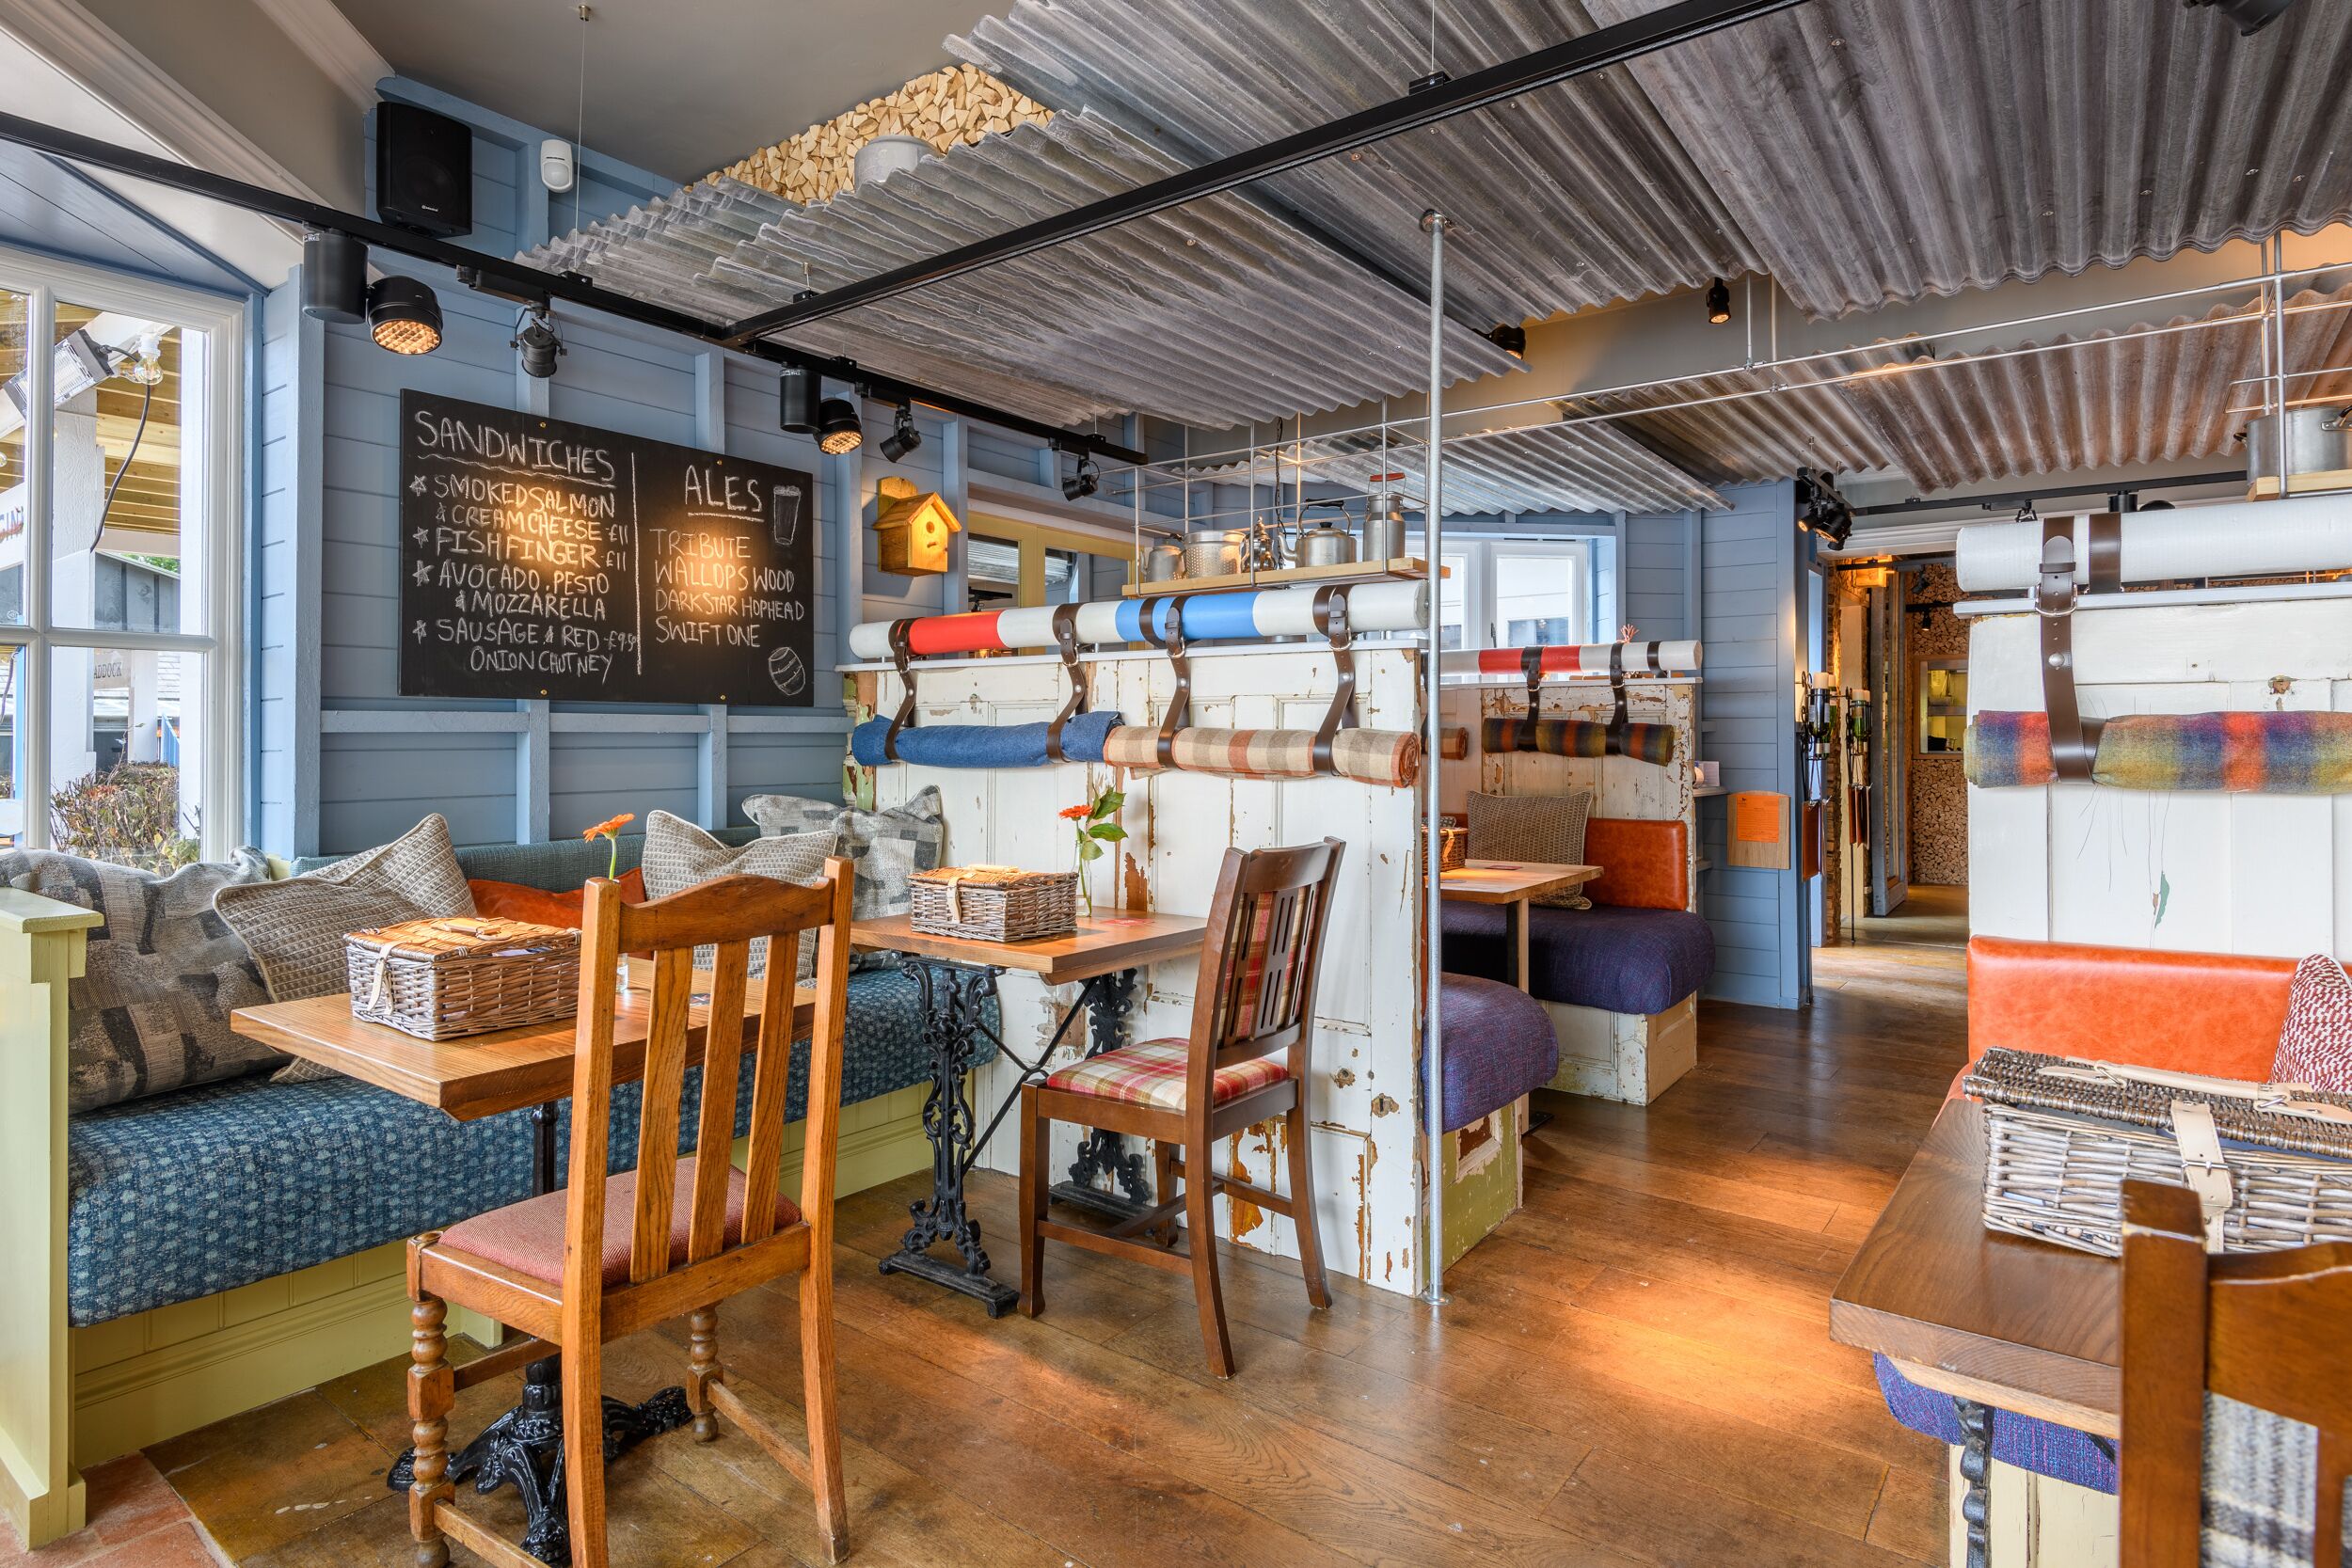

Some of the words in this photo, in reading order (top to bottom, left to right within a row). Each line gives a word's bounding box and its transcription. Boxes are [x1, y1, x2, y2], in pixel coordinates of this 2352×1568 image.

[414, 410, 616, 482] SANDWICHES
[685, 465, 763, 513] ALES
[436, 526, 501, 562] FISH
[506, 535, 601, 568] FINGER
[649, 529, 751, 559] TRIBUTE
[553, 570, 610, 596] PESTO
[470, 589, 607, 622] MOZZARELLA
[741, 596, 804, 622] HOPHEAD
[436, 617, 540, 645] SAUSAGE
[562, 624, 599, 653] RED
[655, 616, 722, 646] SWIFT
[726, 624, 761, 648] ONE
[94, 661, 122, 679] ADDOCK
[470, 645, 535, 672] ONION
[538, 650, 613, 686] CHUTNEY
